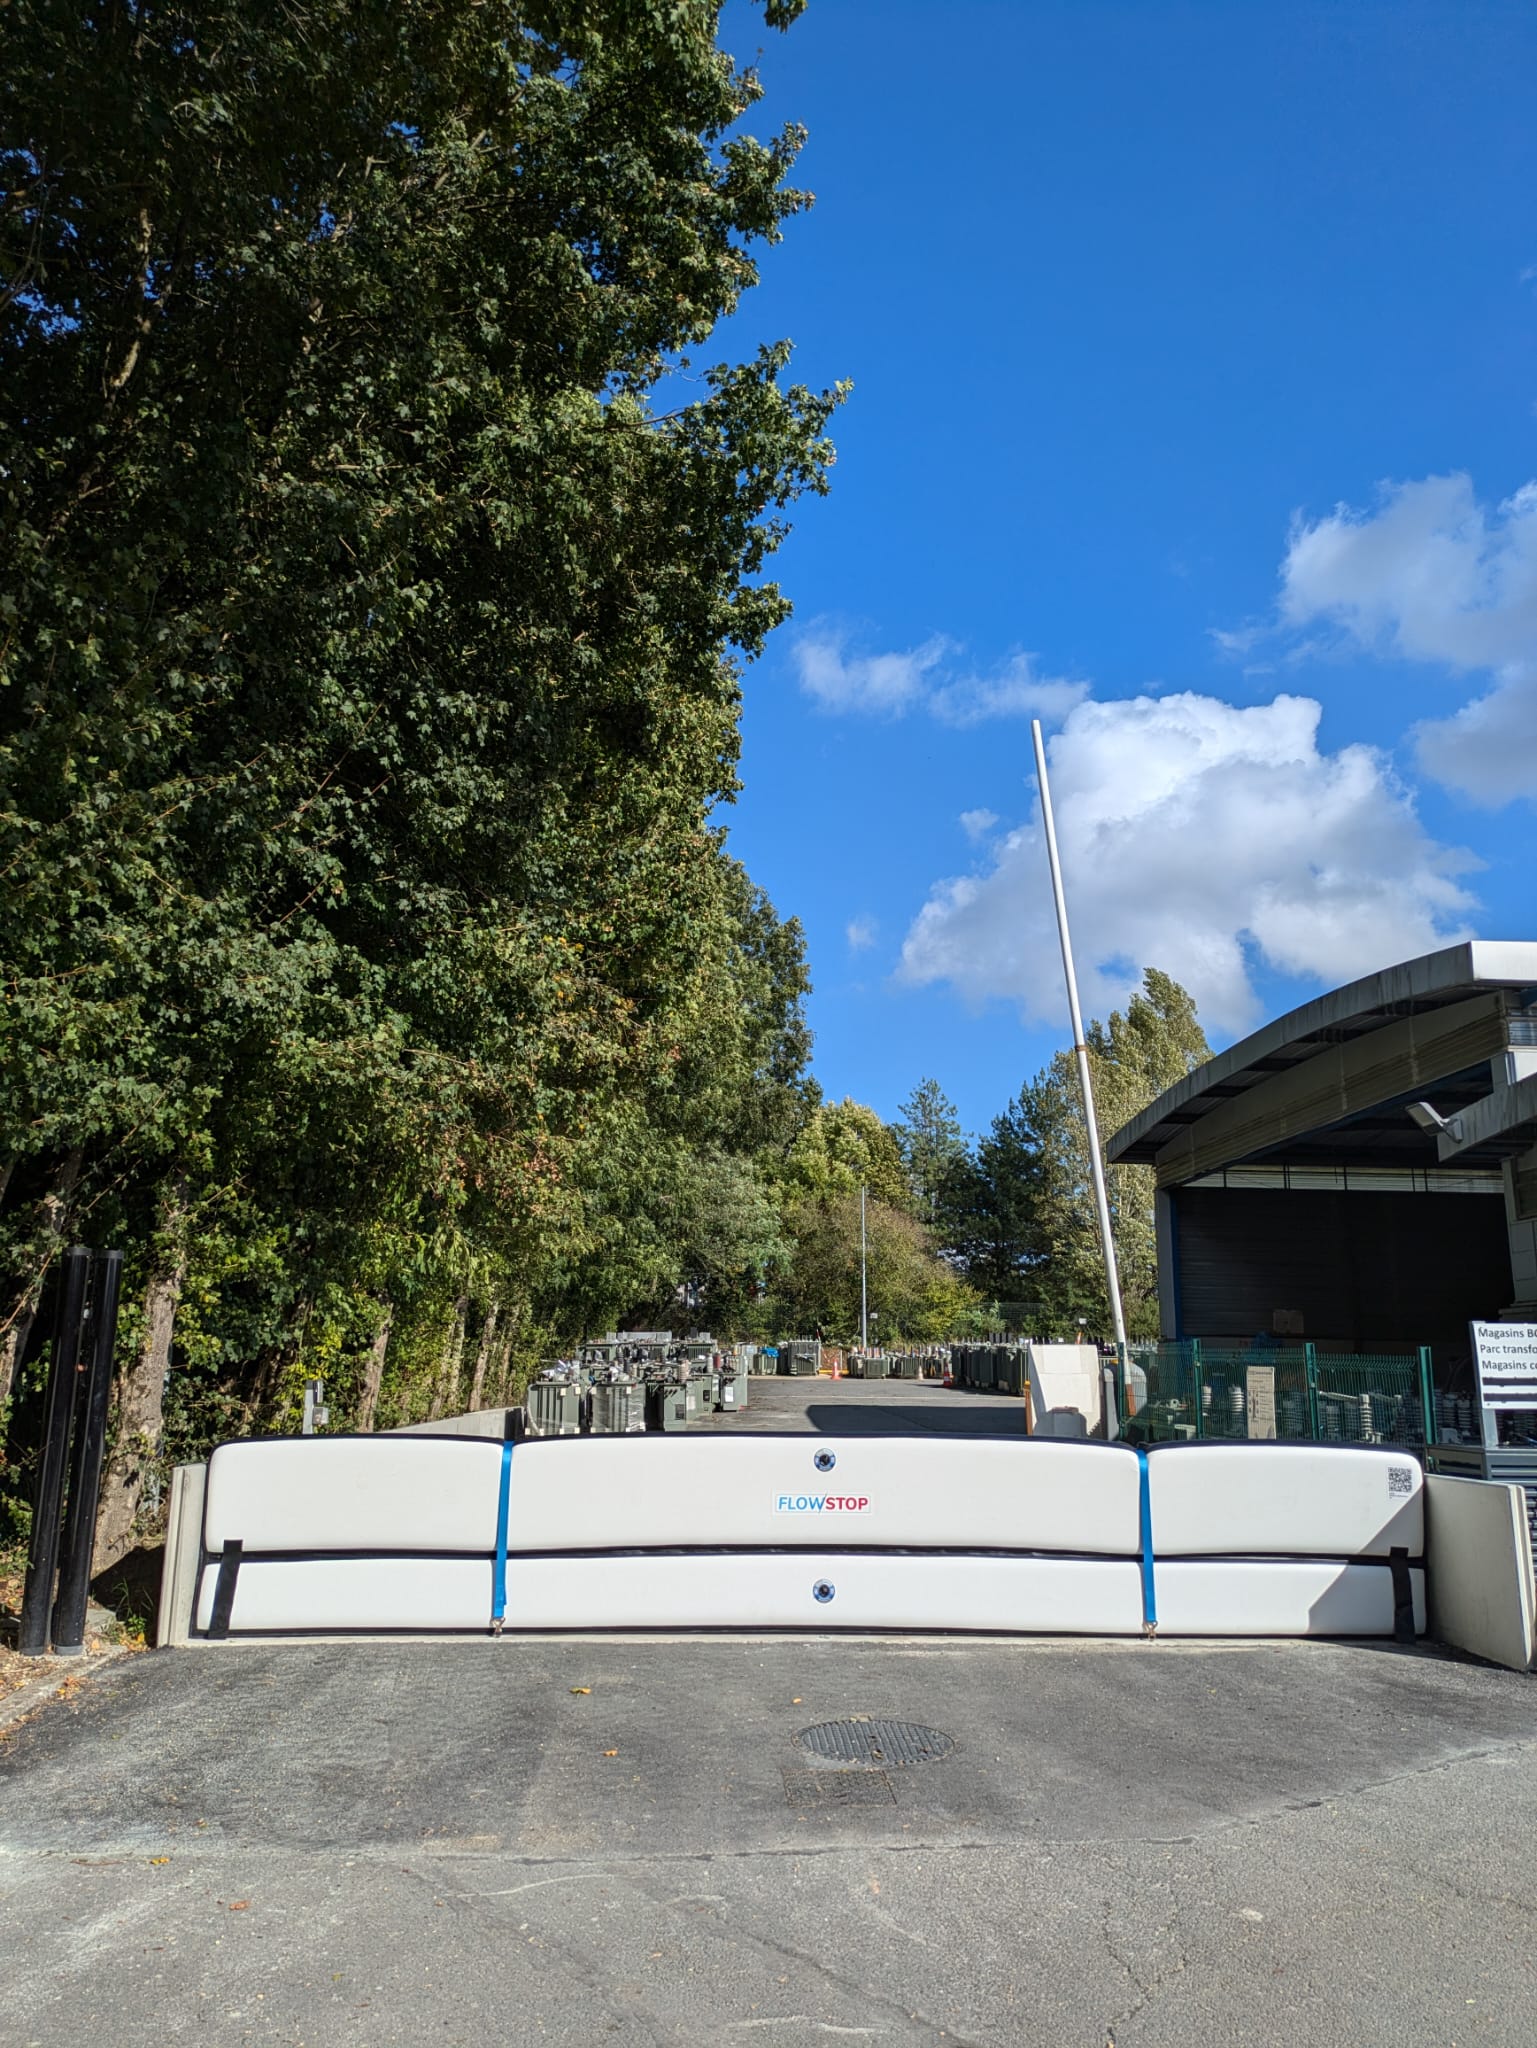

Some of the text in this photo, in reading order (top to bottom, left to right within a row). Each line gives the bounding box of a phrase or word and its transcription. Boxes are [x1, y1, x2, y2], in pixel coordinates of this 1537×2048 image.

[1478, 1327, 1524, 1340] Magasins
[1480, 1343, 1537, 1354] Parc transfo
[1482, 1360, 1527, 1372] Magasins
[778, 1495, 868, 1512] FLOWSTOP
